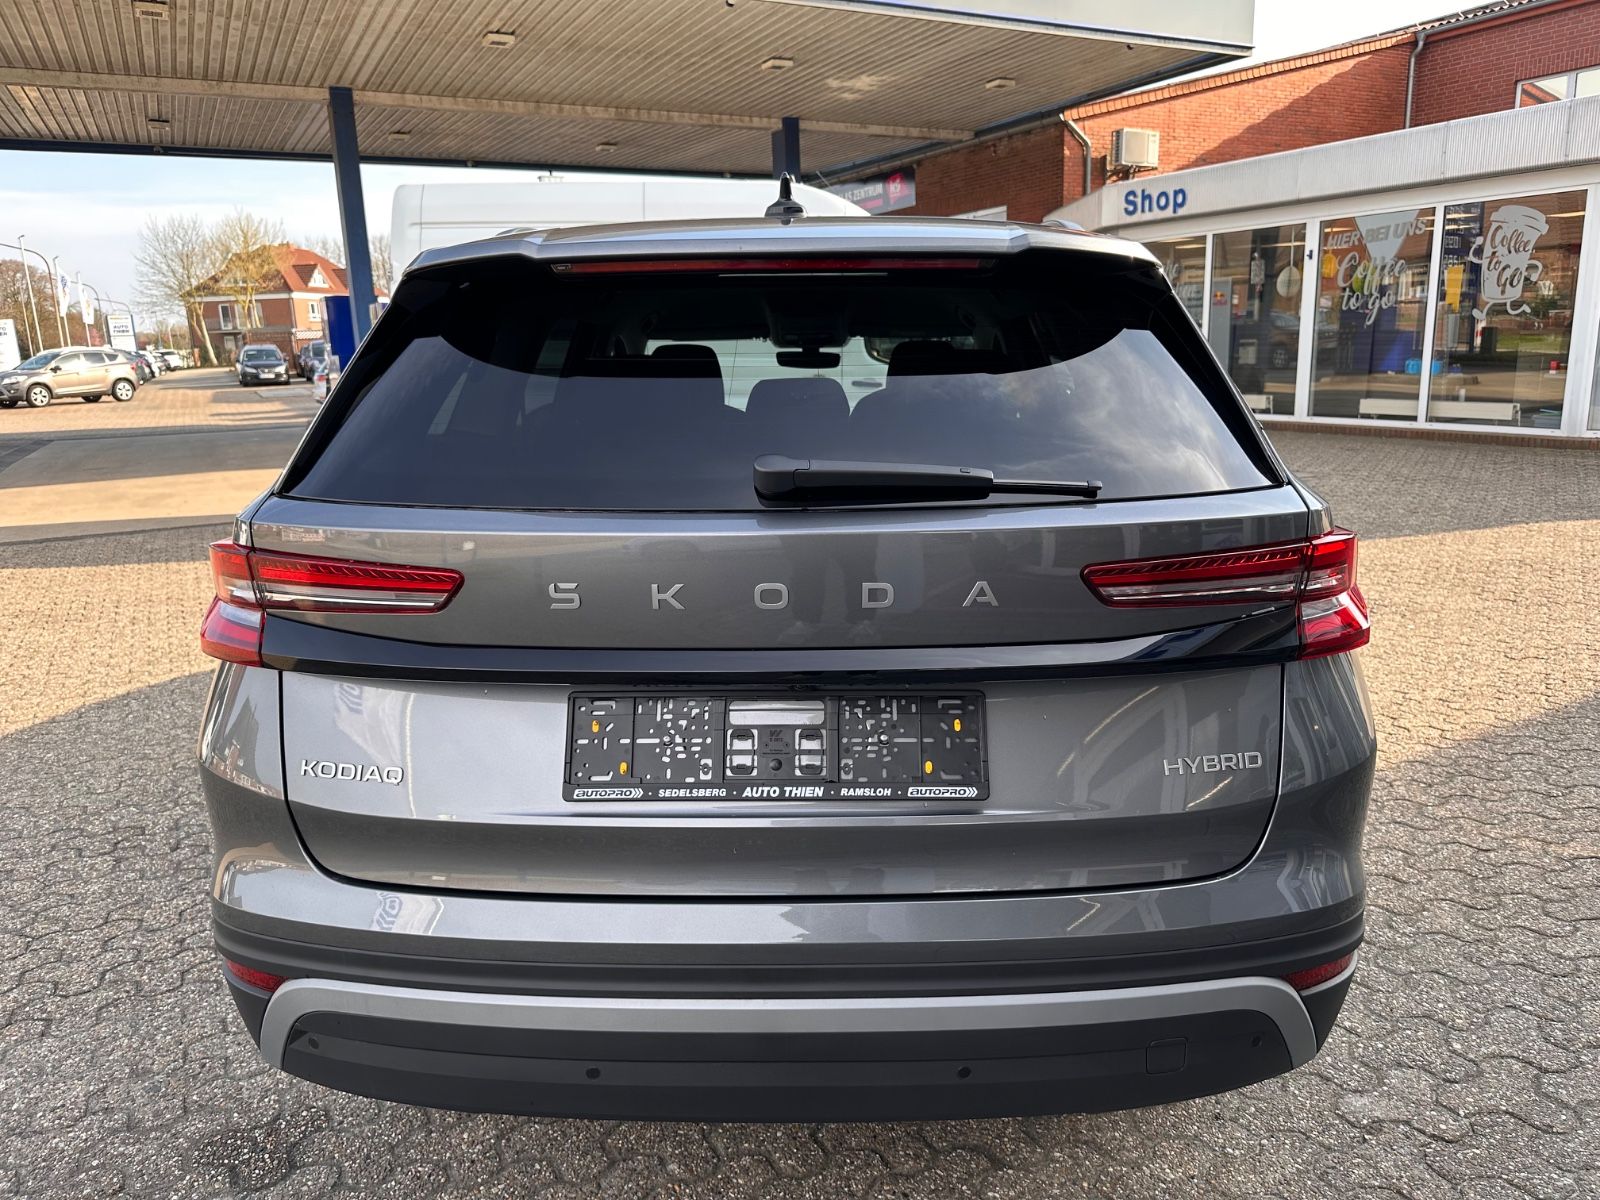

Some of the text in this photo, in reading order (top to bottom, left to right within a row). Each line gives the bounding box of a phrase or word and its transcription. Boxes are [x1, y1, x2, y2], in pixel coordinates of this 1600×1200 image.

[1124, 188, 1186, 216] Shop
[1327, 231, 1361, 248] HIER
[1364, 225, 1391, 243] BEI
[1392, 220, 1427, 239] UNS
[1490, 225, 1531, 254] Coffee
[1337, 251, 1407, 296] Coffee
[1485, 251, 1501, 272] to
[1341, 287, 1396, 328] to go
[548, 581, 1000, 610] SKODA
[300, 759, 404, 786] KODIAQ
[1163, 752, 1263, 776] HYBRID
[658, 788, 727, 797] SEDELSBERG
[742, 786, 781, 798] AUTO
[783, 786, 825, 798] THIEN
[840, 787, 892, 797] RAMSLOH
